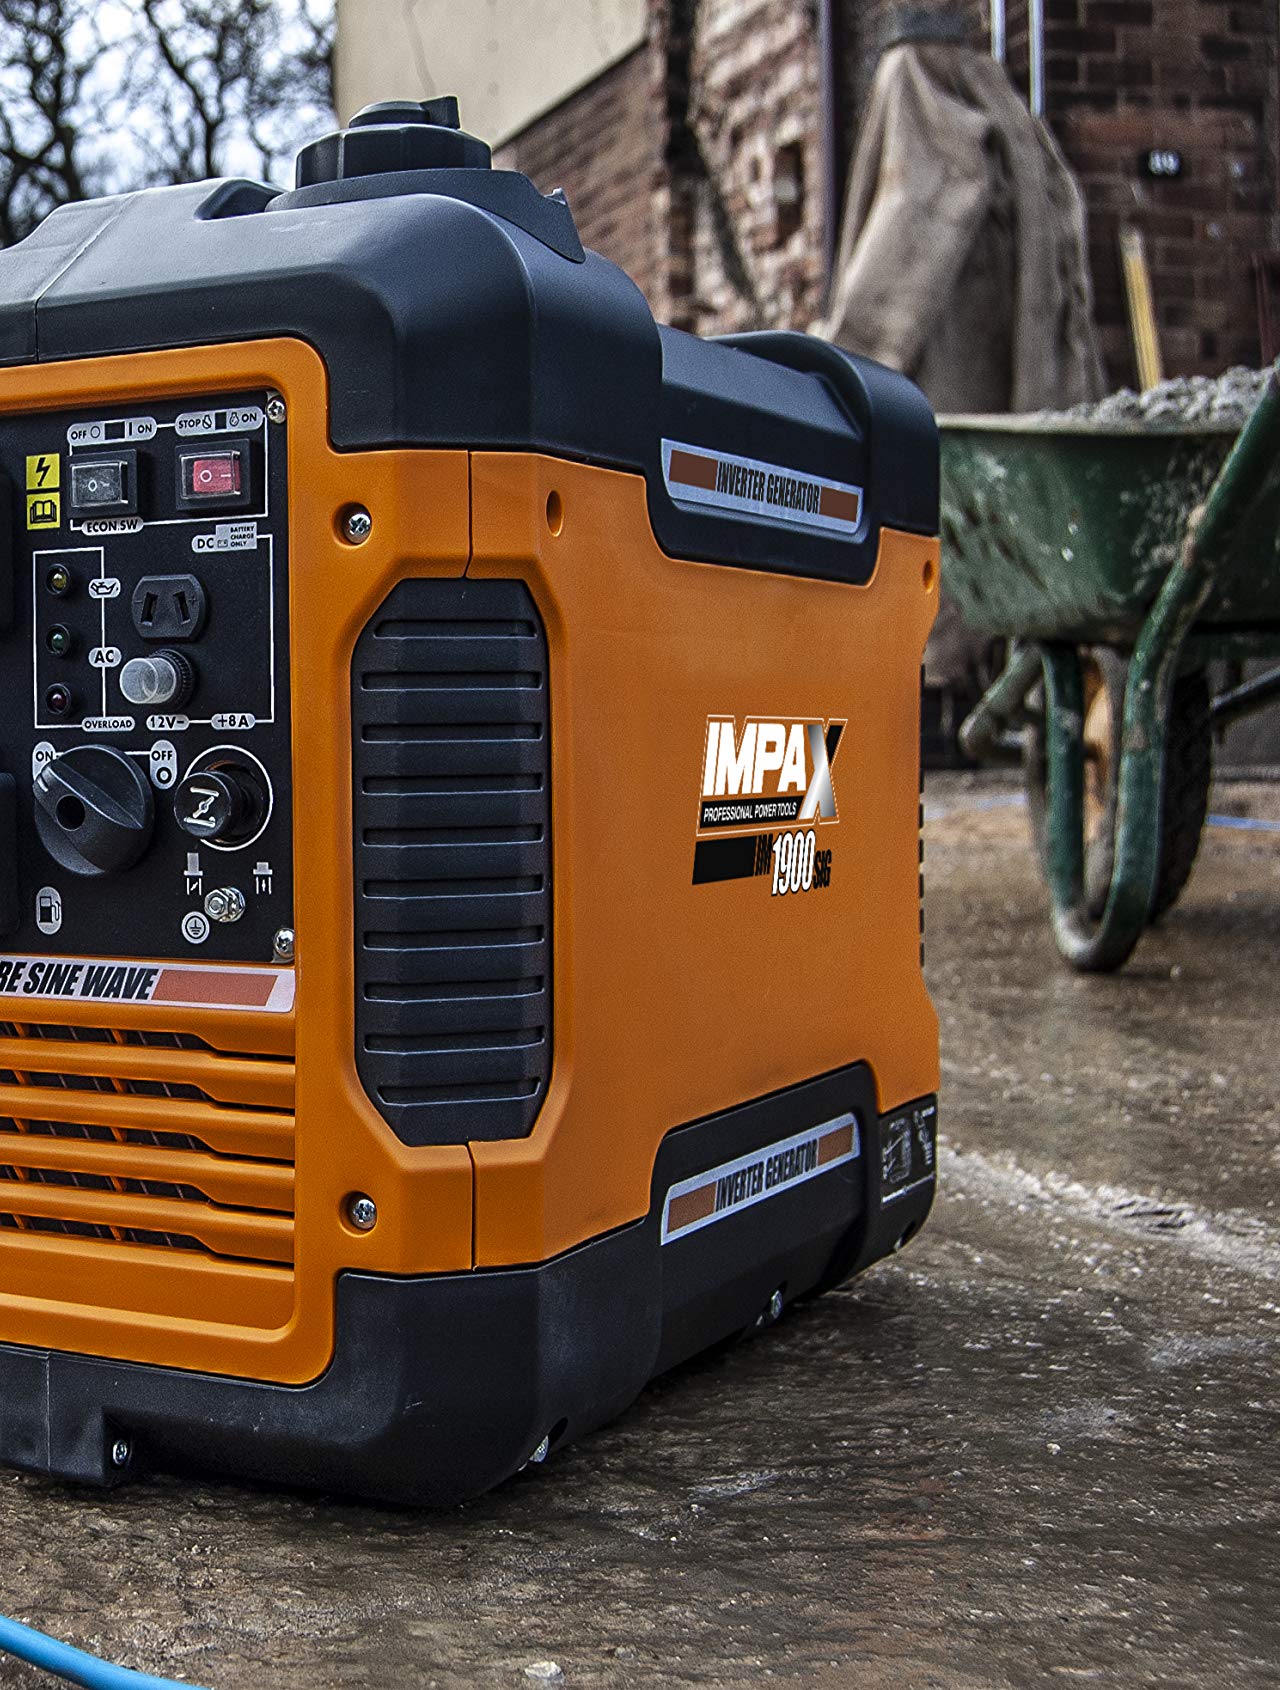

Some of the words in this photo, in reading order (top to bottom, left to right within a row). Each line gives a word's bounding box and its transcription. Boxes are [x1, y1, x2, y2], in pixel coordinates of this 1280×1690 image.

[178, 418, 201, 429] STOP
[241, 413, 257, 423] ON
[70, 430, 87, 440] OFF
[137, 424, 153, 434] ON
[716, 461, 766, 502] INVERTER
[766, 473, 820, 515] GENERATOR
[230, 525, 255, 533] BATTERY
[197, 537, 215, 549] DC
[230, 540, 247, 548] ONLY
[94, 649, 115, 664] AC
[84, 718, 133, 730] OVERLOAD
[35, 750, 54, 762] ON
[151, 749, 173, 761] OFF
[702, 721, 844, 820] IMPAX
[703, 805, 754, 823] PROFESSIONAL
[754, 803, 777, 820] POWER
[777, 801, 798, 818] TOOLS
[23, 962, 84, 996] SINE
[80, 965, 159, 1000] WAVE
[715, 1161, 765, 1213] INVERTER
[765, 1138, 819, 1190] GENERATOR
